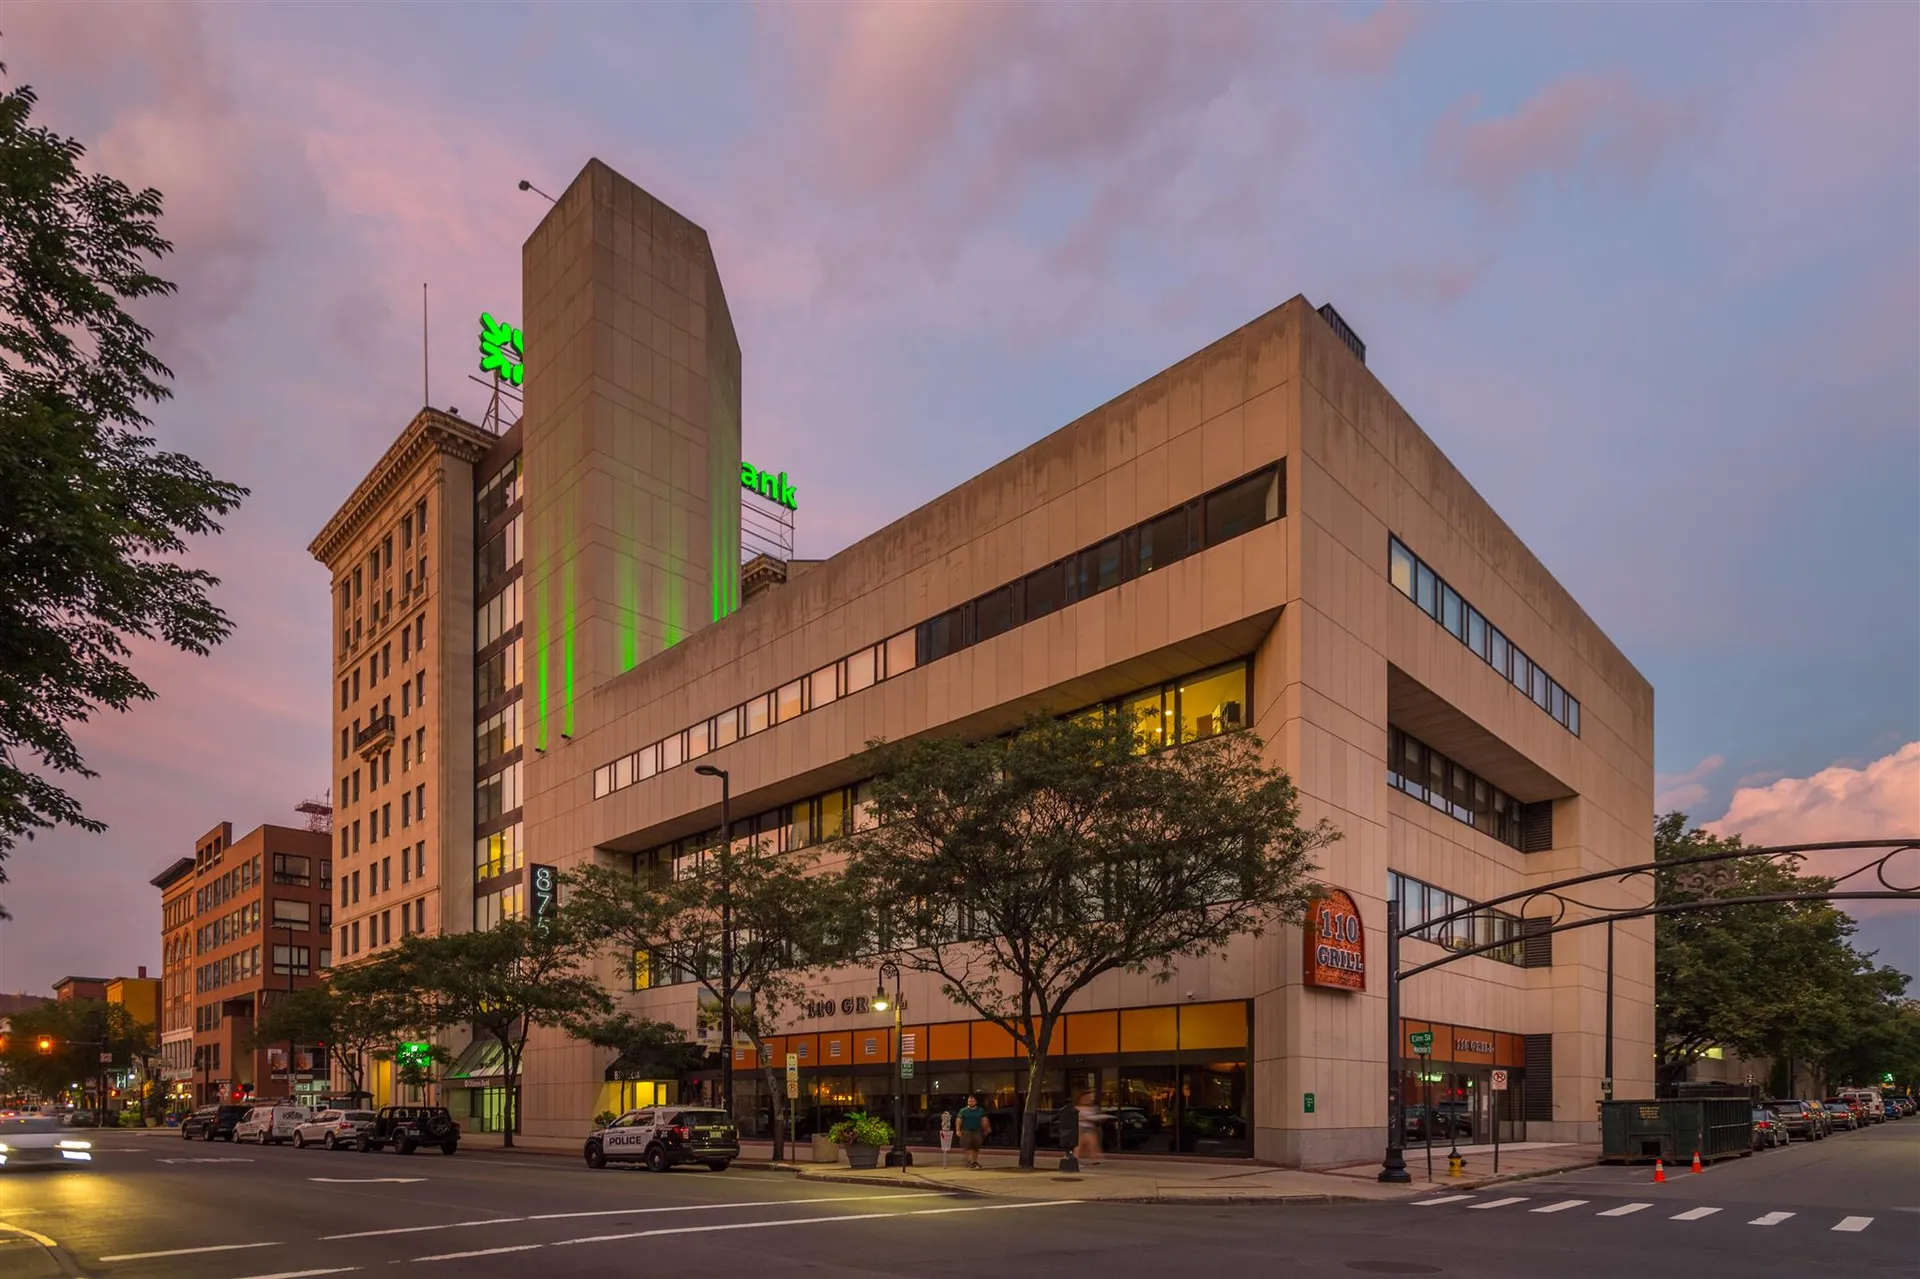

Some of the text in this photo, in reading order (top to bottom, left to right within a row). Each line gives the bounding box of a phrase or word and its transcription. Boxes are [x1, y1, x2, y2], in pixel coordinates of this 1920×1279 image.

[1322, 909, 1359, 943] 110
[1317, 944, 1364, 973] GRILL
[807, 999, 836, 1018] 110
[1411, 1033, 1432, 1043] Elm St
[609, 1136, 642, 1146] POLICE
